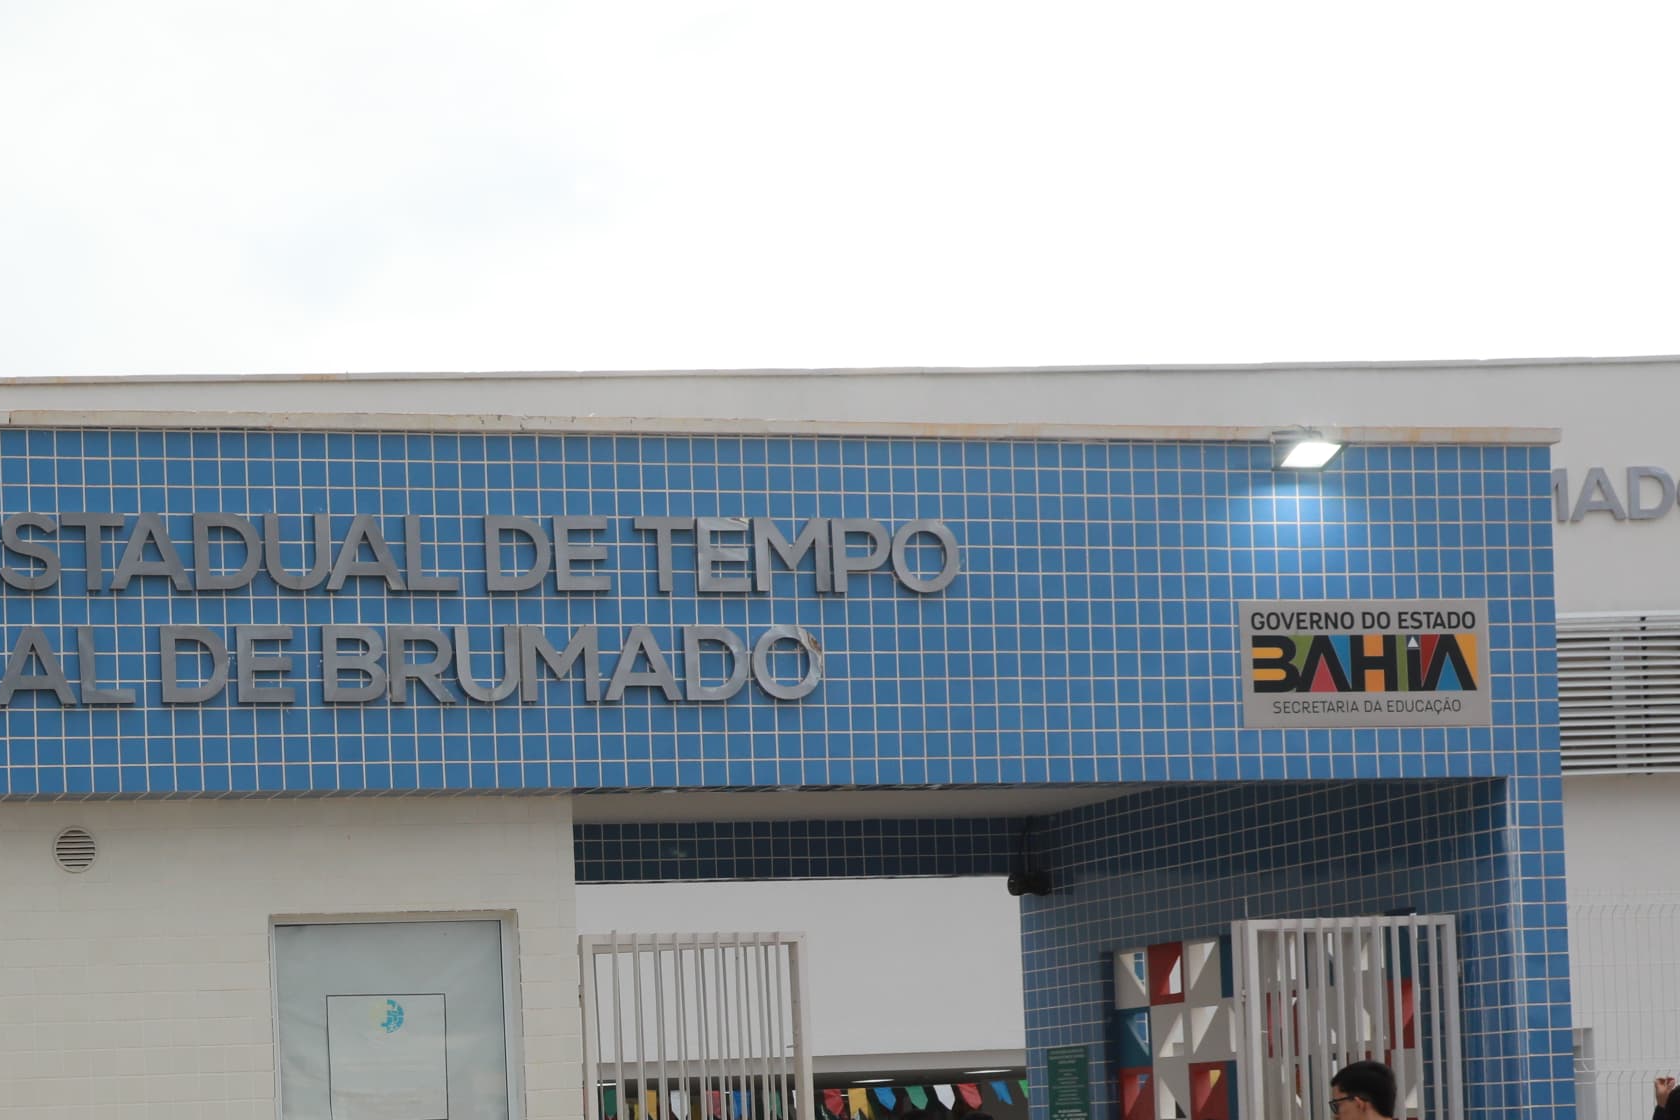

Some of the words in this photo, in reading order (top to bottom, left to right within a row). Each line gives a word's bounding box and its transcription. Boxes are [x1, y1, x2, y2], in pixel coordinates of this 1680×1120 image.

[1551, 466, 1680, 523] AD
[485, 512, 612, 593] DE
[634, 515, 962, 594] TEMPO
[1251, 611, 1355, 631] GOVERNO
[1361, 611, 1391, 630] DO
[1398, 611, 1476, 630] ESTADO
[160, 624, 296, 705] DE
[321, 624, 824, 705] BRUMADO
[1251, 634, 1478, 693] BAHIA
[1272, 700, 1360, 714] SECRETARIA
[1364, 700, 1383, 713] DA
[1386, 696, 1462, 715] EDUCAÇÃO
